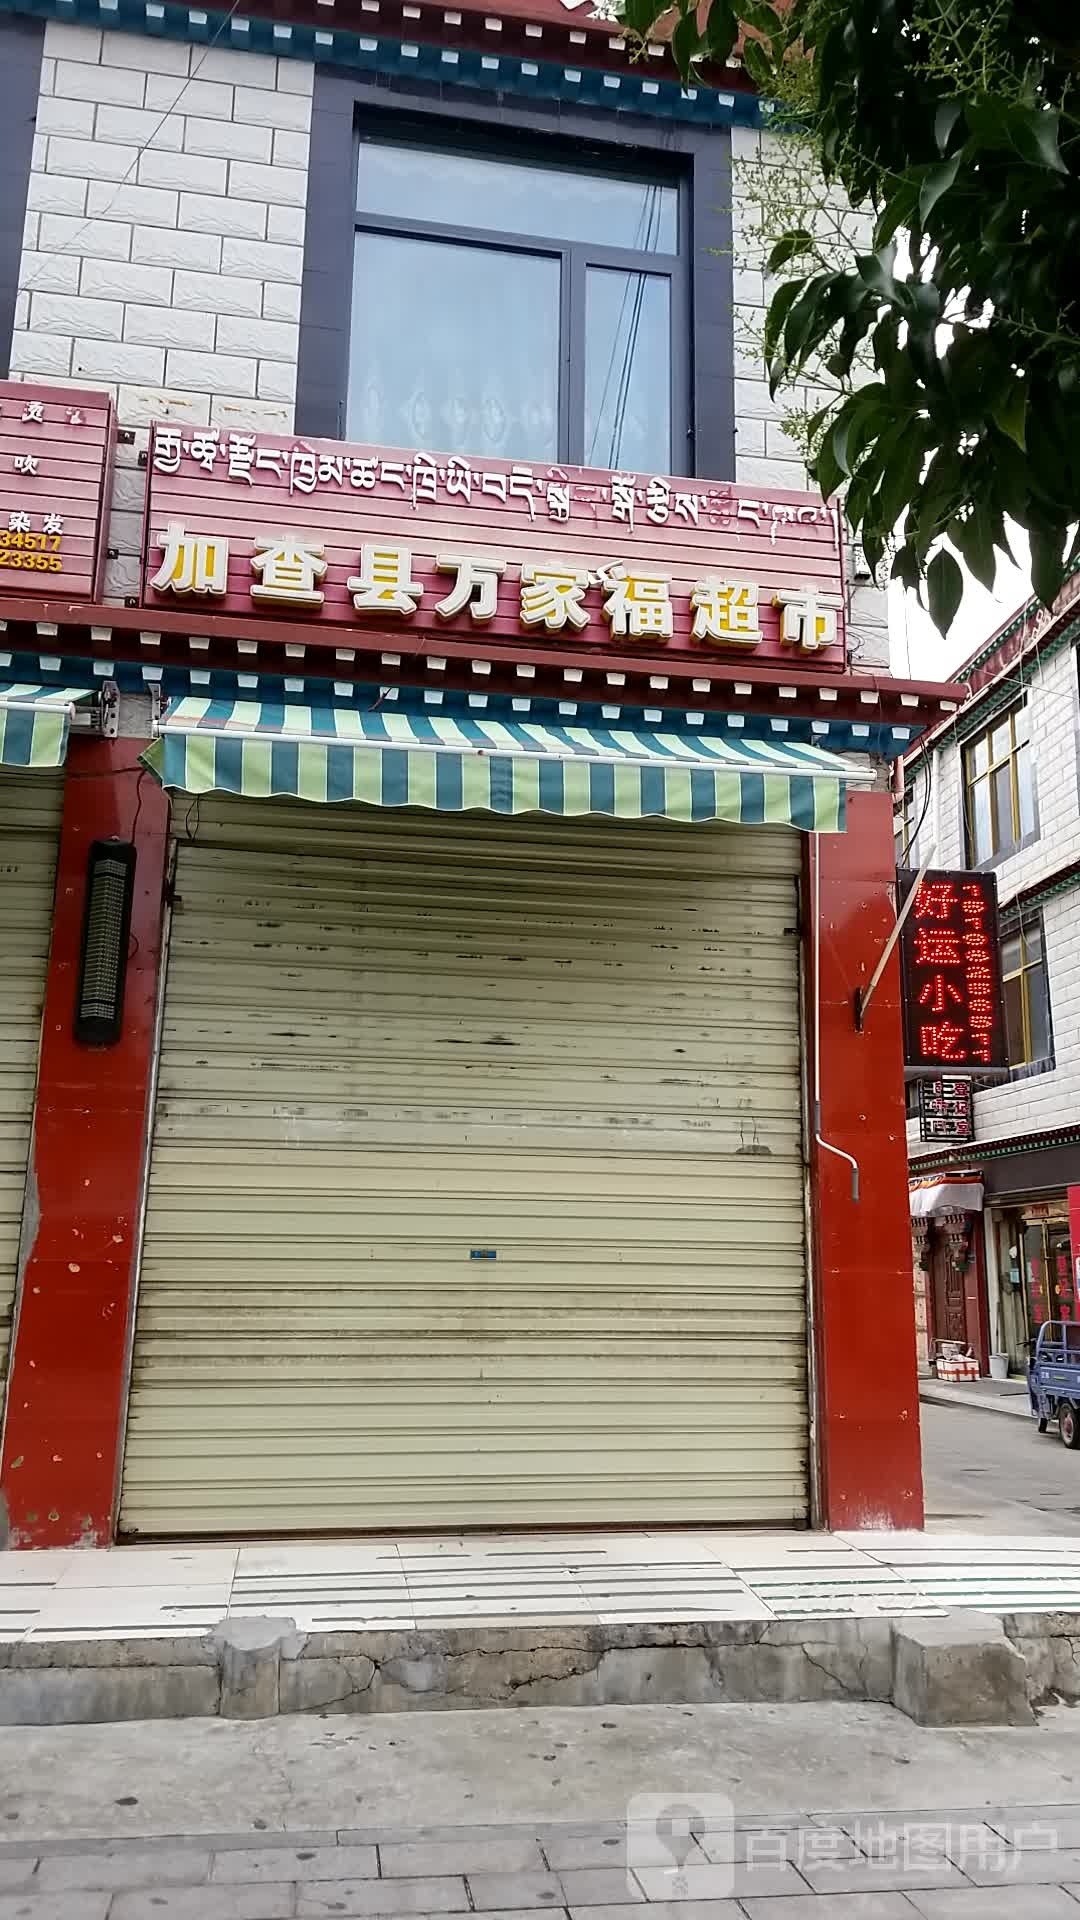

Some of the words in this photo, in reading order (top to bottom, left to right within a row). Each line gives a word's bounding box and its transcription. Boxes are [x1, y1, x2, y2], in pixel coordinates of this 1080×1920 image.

[14, 455, 39, 475] 吹
[8, 511, 64, 535] 染发
[0, 531, 62, 552] 34517
[0, 551, 63, 572] 23355
[150, 521, 845, 652] 加查县万家福超市
[914, 881, 965, 1060] 好运小吃
